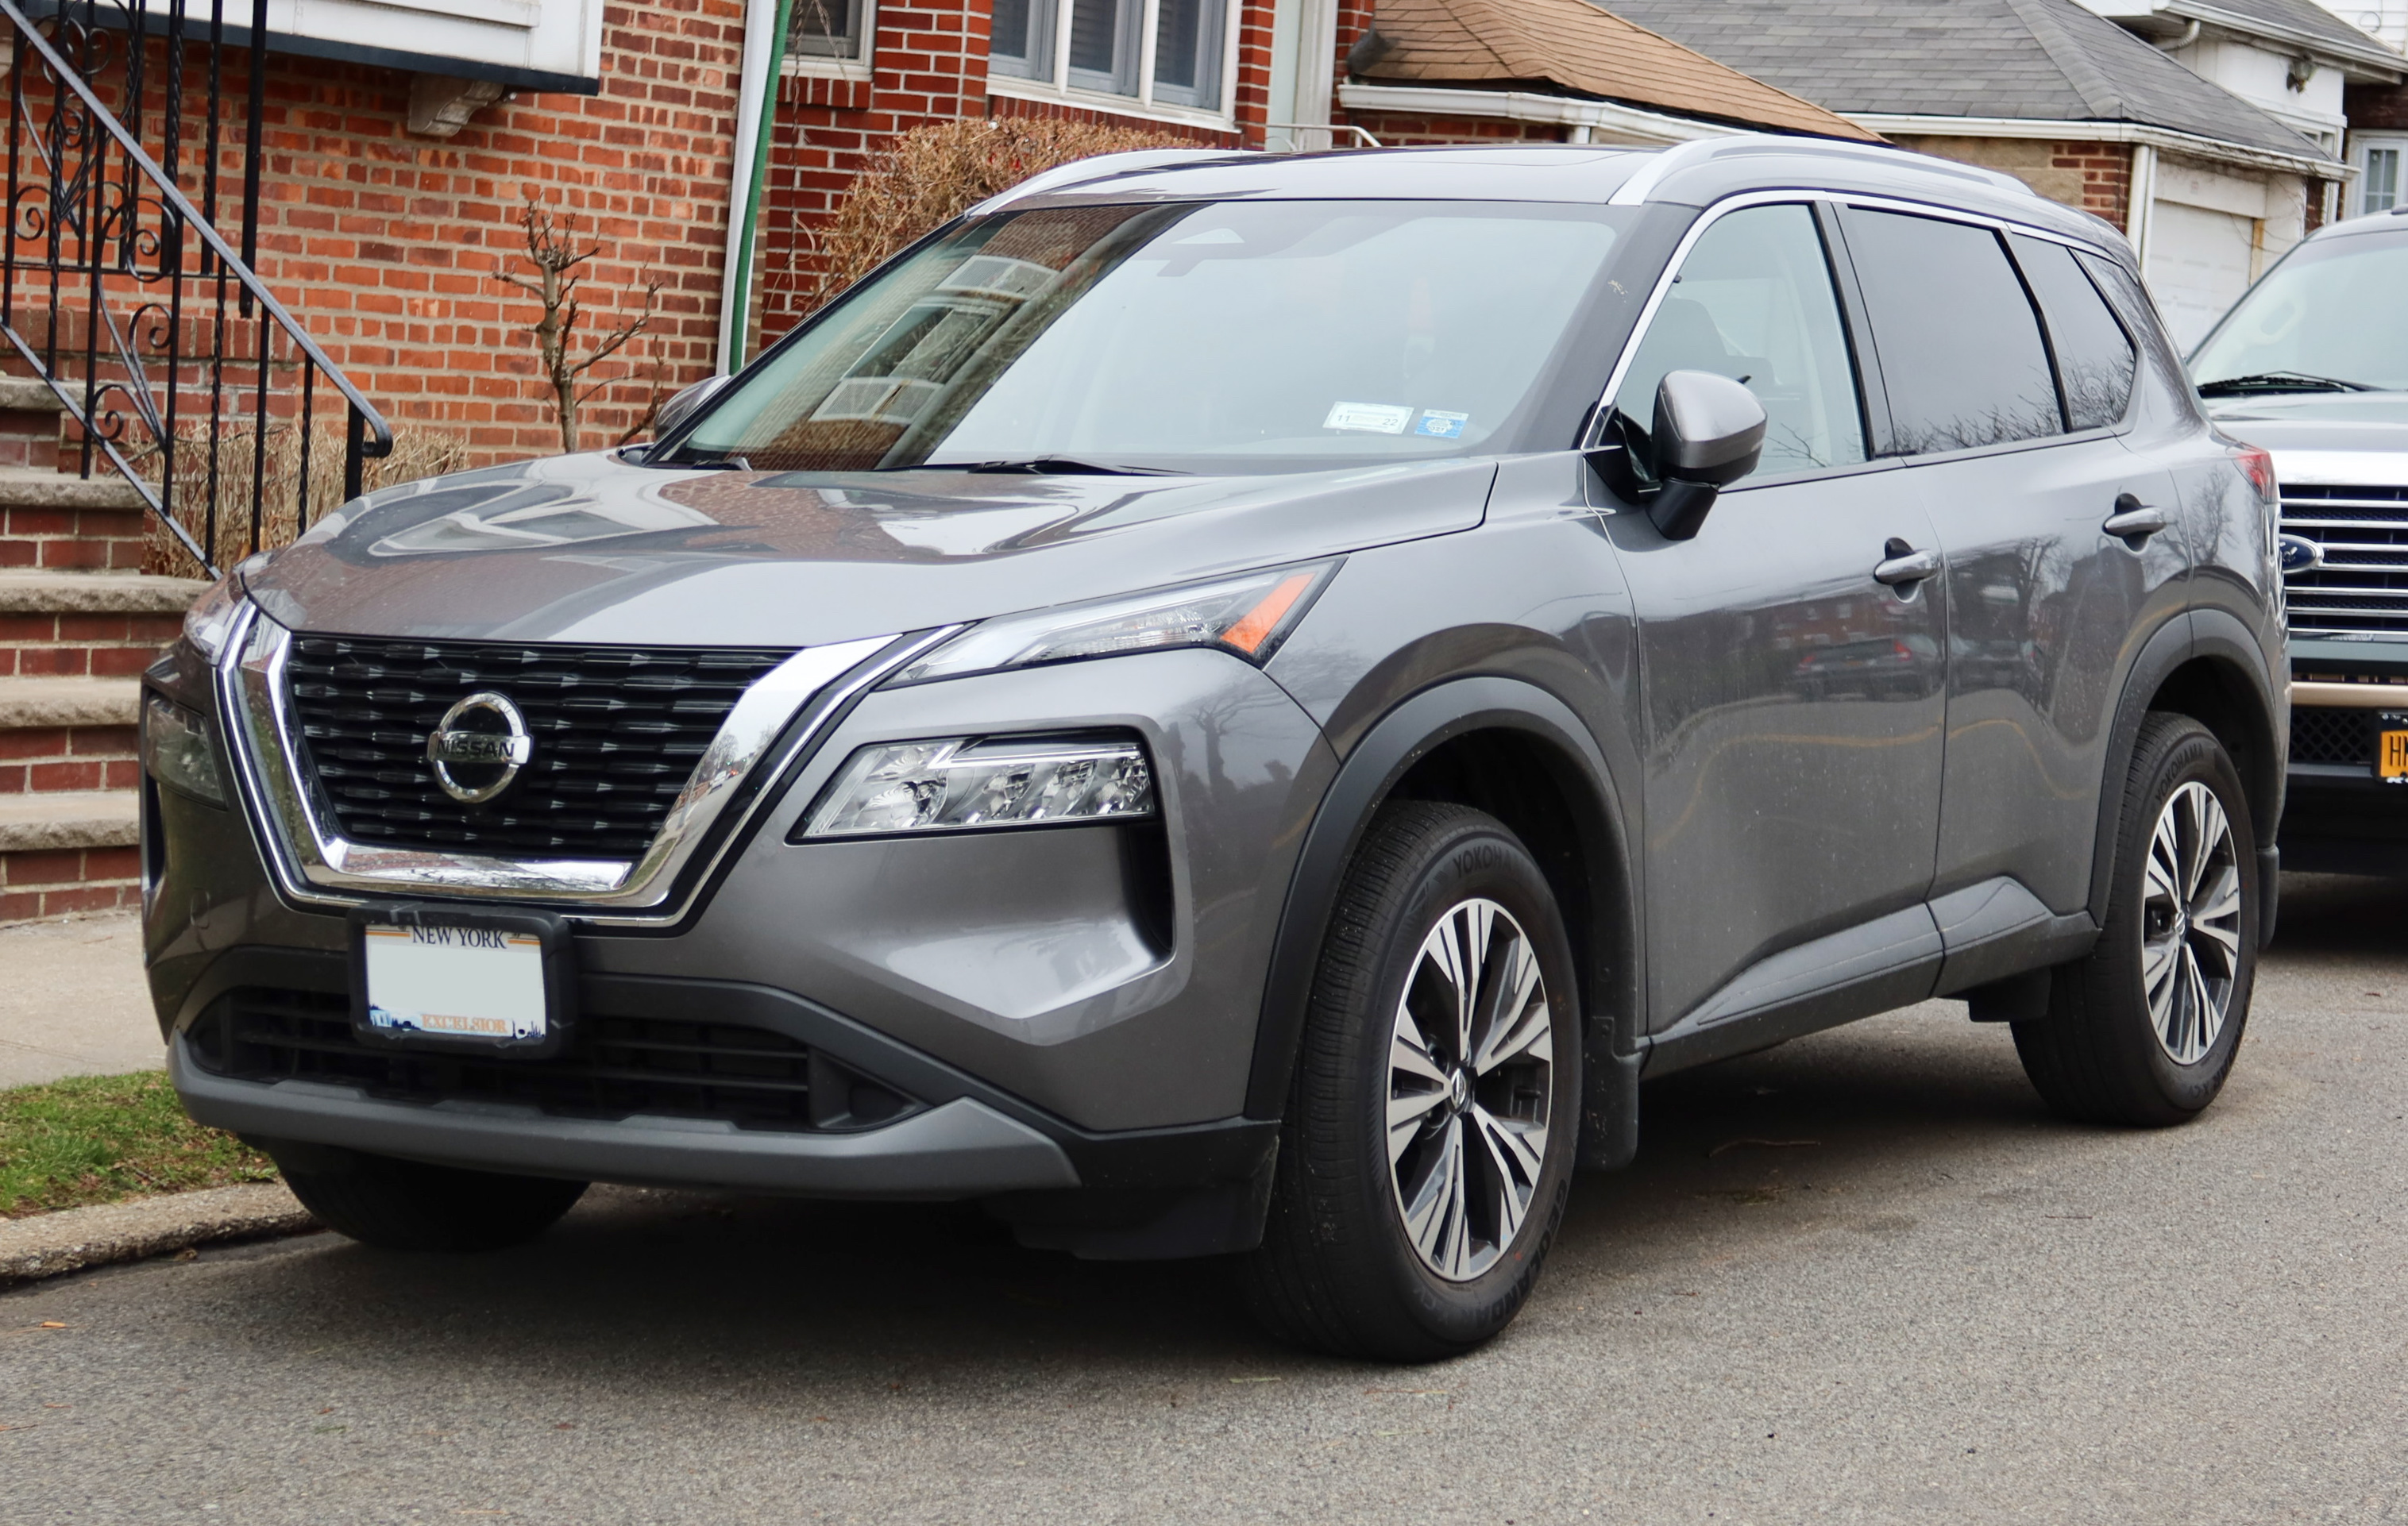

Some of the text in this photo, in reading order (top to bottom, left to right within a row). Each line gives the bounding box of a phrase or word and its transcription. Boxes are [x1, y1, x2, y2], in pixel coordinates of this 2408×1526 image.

[1382, 418, 1399, 426] 22
[436, 739, 515, 758] NISSAN
[2154, 742, 2205, 805] YOKOHAMA
[412, 926, 507, 950] NEW YORK
[421, 1013, 507, 1034] EXCELSIOR
